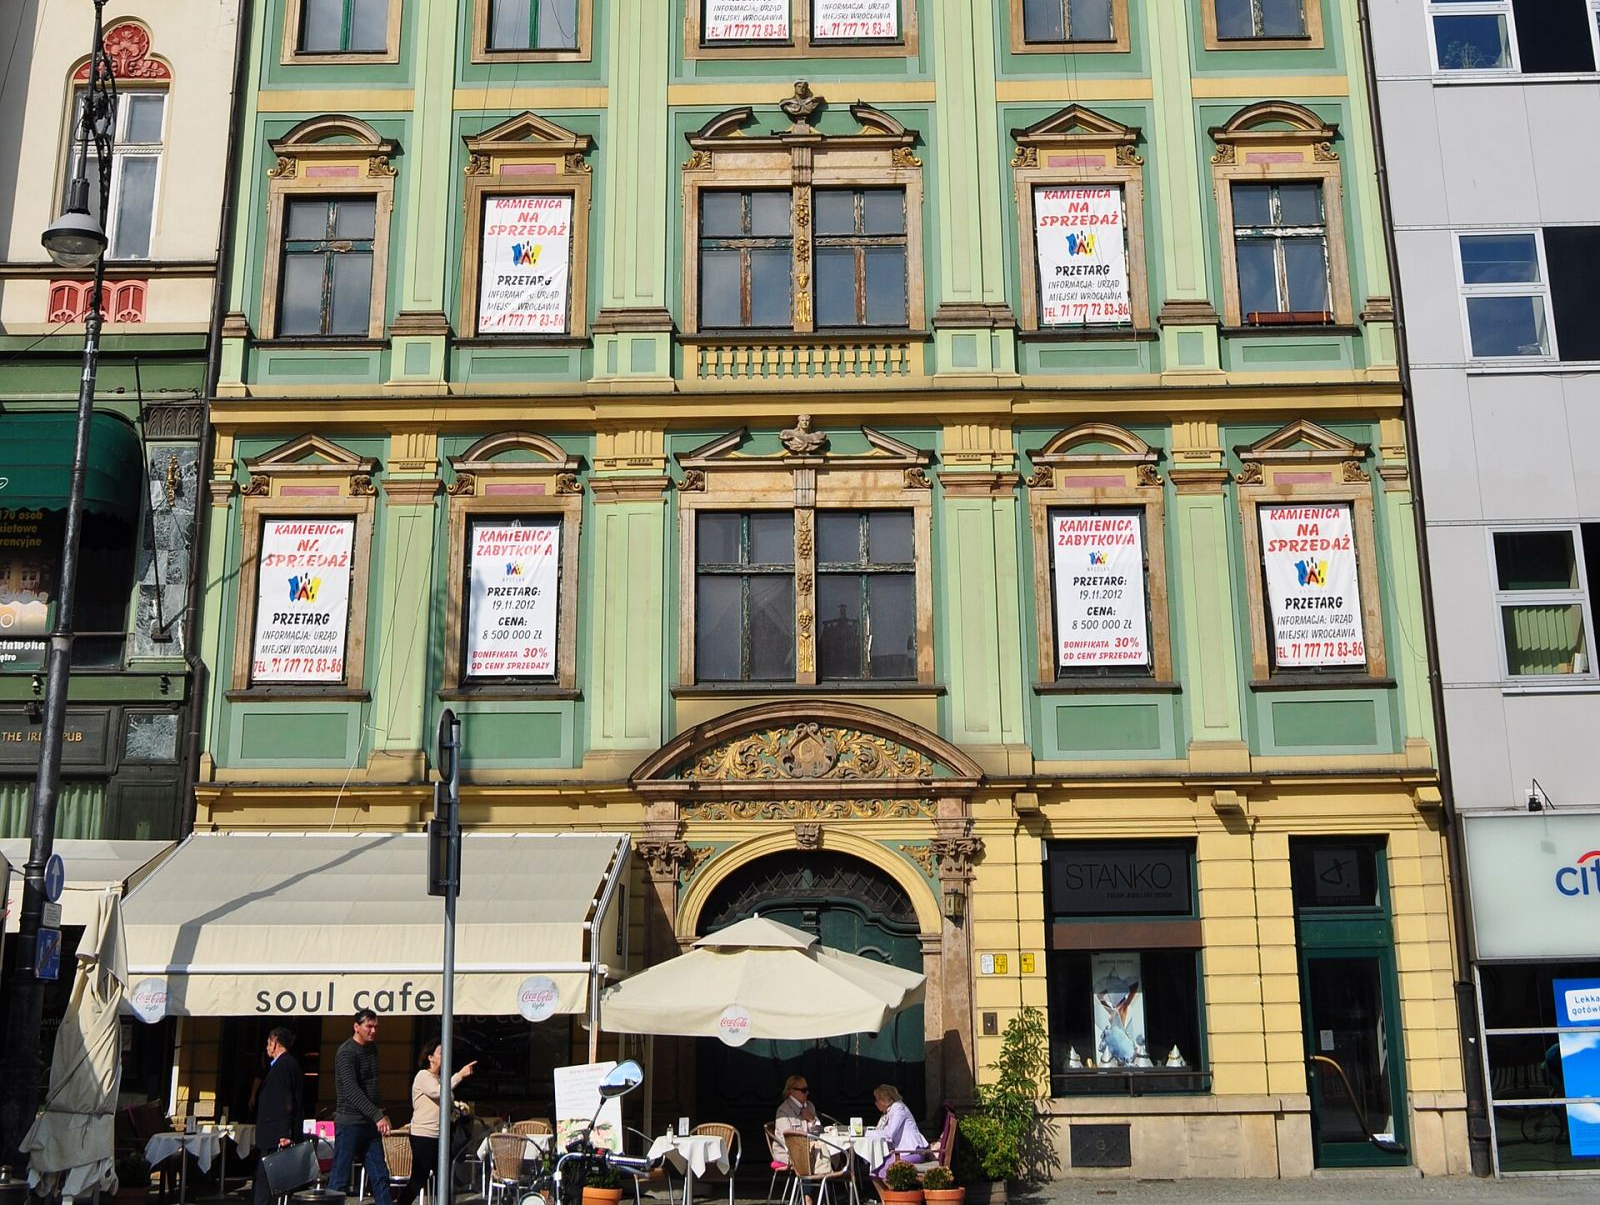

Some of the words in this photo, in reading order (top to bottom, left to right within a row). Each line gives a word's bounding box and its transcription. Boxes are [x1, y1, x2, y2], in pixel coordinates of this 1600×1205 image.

[724, 25, 732, 37] 71
[735, 24, 749, 37] 777
[752, 24, 761, 36] 72
[764, 24, 787, 37] 83-86
[831, 24, 840, 36] 71
[843, 23, 857, 36] 777
[860, 23, 869, 35] 72
[1044, 189, 1110, 199] KAMIENICA
[496, 199, 562, 209] KAMIENICA
[1068, 202, 1089, 212] NA
[518, 212, 538, 222] NA
[1040, 211, 1118, 226] SPRZEDAŻ
[488, 222, 566, 236] SPRZEDAŻ
[1056, 265, 1110, 276] PRZETARG
[1061, 305, 1069, 316] 71
[1073, 304, 1088, 316] 777
[1092, 304, 1101, 315] 72
[1105, 303, 1128, 315] 83-86
[509, 314, 525, 326] 777
[1270, 509, 1340, 520] KAMIENICA
[1297, 524, 1319, 536] NA
[1268, 534, 1350, 552] SPRZEDAŻ
[1073, 577, 1127, 586] PRZETARG:
[487, 587, 541, 596] PRZETARG:
[1080, 590, 1122, 599] 19.11.2012
[493, 601, 535, 610] 19.11.2012
[1285, 597, 1343, 609] PRZETARG
[1087, 607, 1116, 615] CENA:
[273, 613, 330, 625] PRZETARG
[499, 617, 527, 626] CENA:
[1072, 620, 1077, 629] 8
[1081, 620, 1098, 629] 500
[1102, 620, 1120, 629] 000
[482, 630, 487, 639] 8
[491, 630, 509, 639] 500
[512, 630, 531, 639] 000
[1115, 637, 1139, 647] 30%
[523, 648, 547, 658] 30%
[1292, 644, 1300, 658] 71
[1305, 643, 1320, 657] 777
[1324, 643, 1334, 657] 72
[1338, 642, 1363, 657] 83-86
[1064, 652, 1074, 660] OD
[272, 659, 281, 672] 71
[284, 659, 301, 672] 777
[303, 659, 314, 672] 72
[316, 659, 342, 673] 83-86
[1, 731, 22, 742] THE
[63, 732, 82, 742] PUB
[1066, 862, 1172, 890] STANKO
[256, 982, 334, 1013] soul
[353, 982, 436, 1013] cafe
